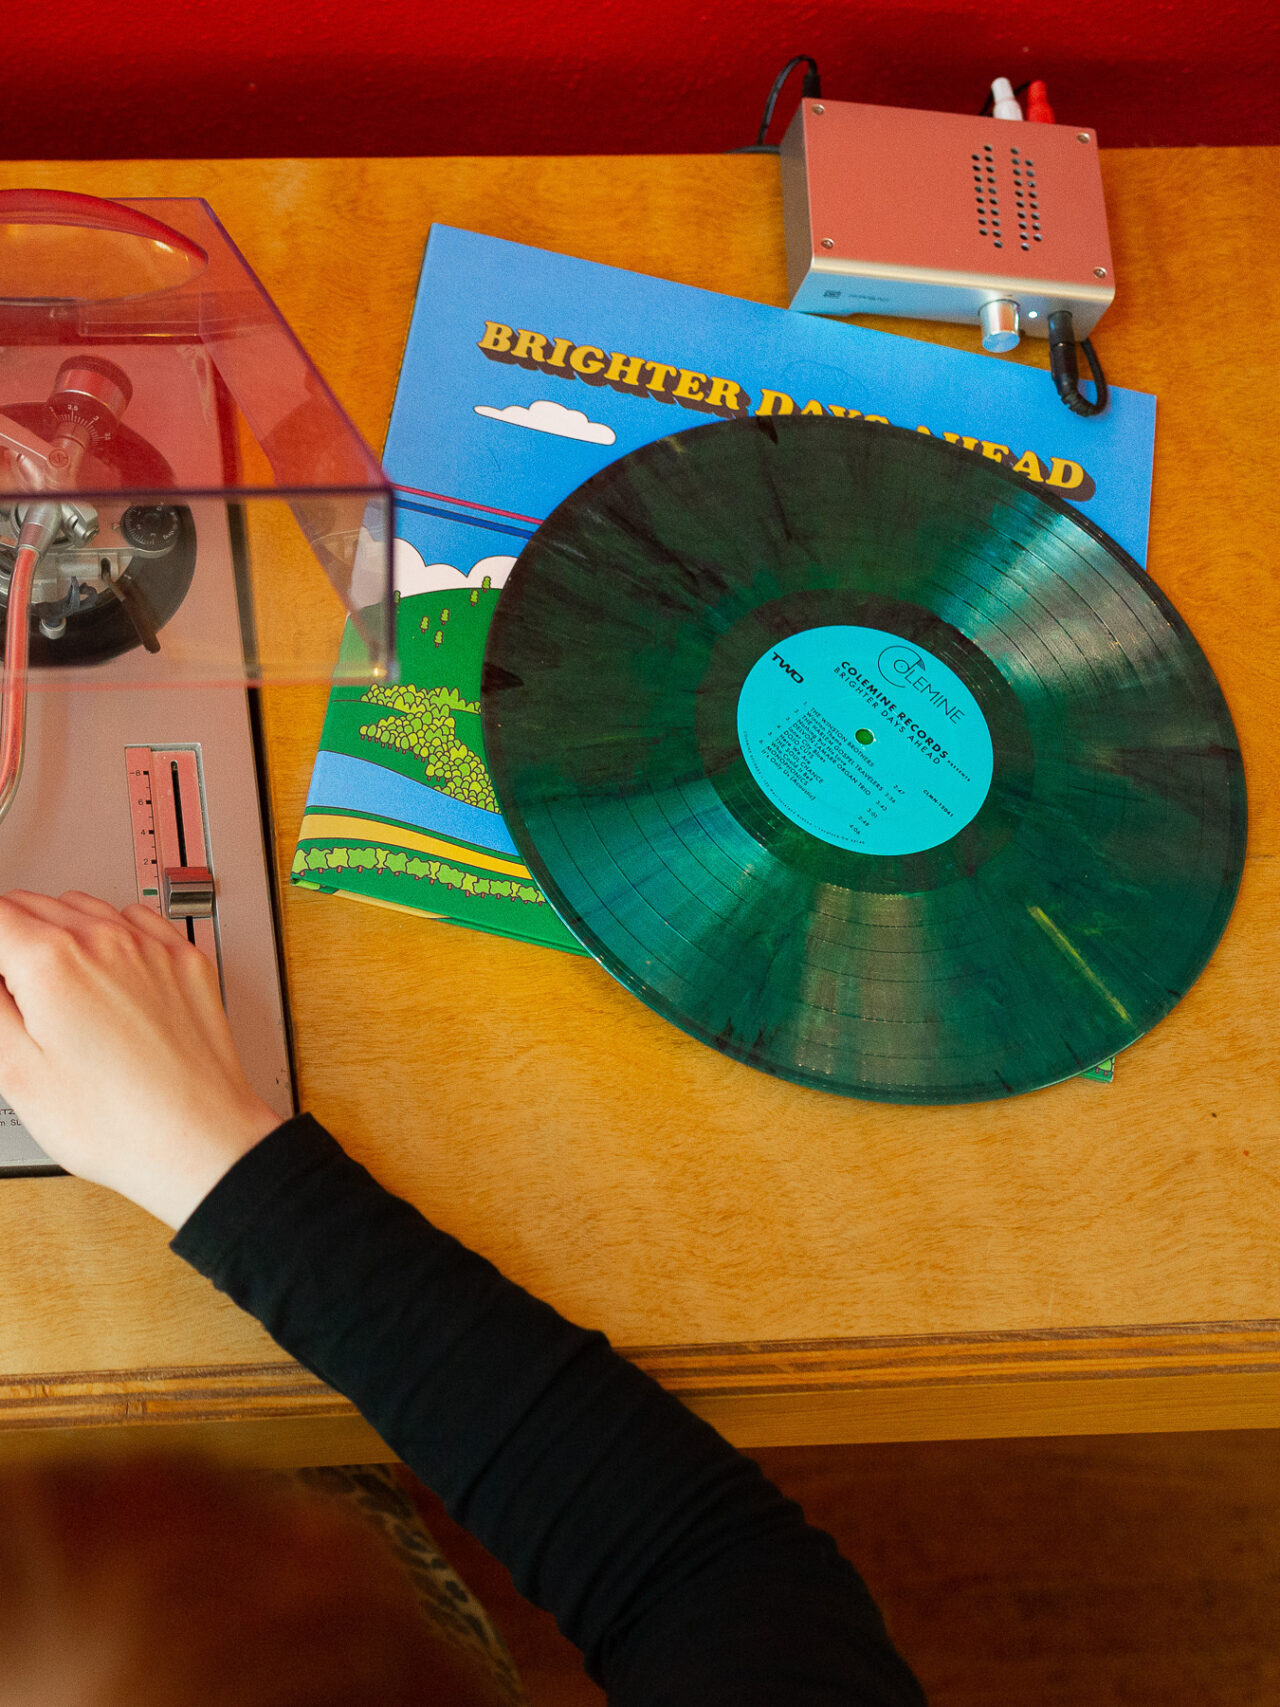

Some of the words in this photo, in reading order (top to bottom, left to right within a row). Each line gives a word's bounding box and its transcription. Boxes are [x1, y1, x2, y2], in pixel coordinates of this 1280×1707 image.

[477, 320, 742, 411] BRIGHTER
[772, 652, 804, 683] TWO
[833, 666, 879, 709] BRIGHTER
[880, 710, 906, 733] DAYS
[906, 734, 941, 764] AHEAD
[841, 661, 897, 712] COLEMINE
[896, 712, 948, 759] RECORDS
[783, 731, 799, 745] DOJO
[799, 745, 813, 758] CUTS
[821, 717, 847, 741] WINSTON
[847, 741, 874, 766] BROTHERS
[765, 745, 808, 785] MONOPHONICS
[784, 748, 800, 762] SOUL
[799, 761, 823, 783] CHANCE
[833, 745, 854, 764] GOSPEL
[855, 764, 883, 790] TRAVELERS
[836, 763, 857, 782] ORGAN
[857, 782, 871, 796] TRIO
